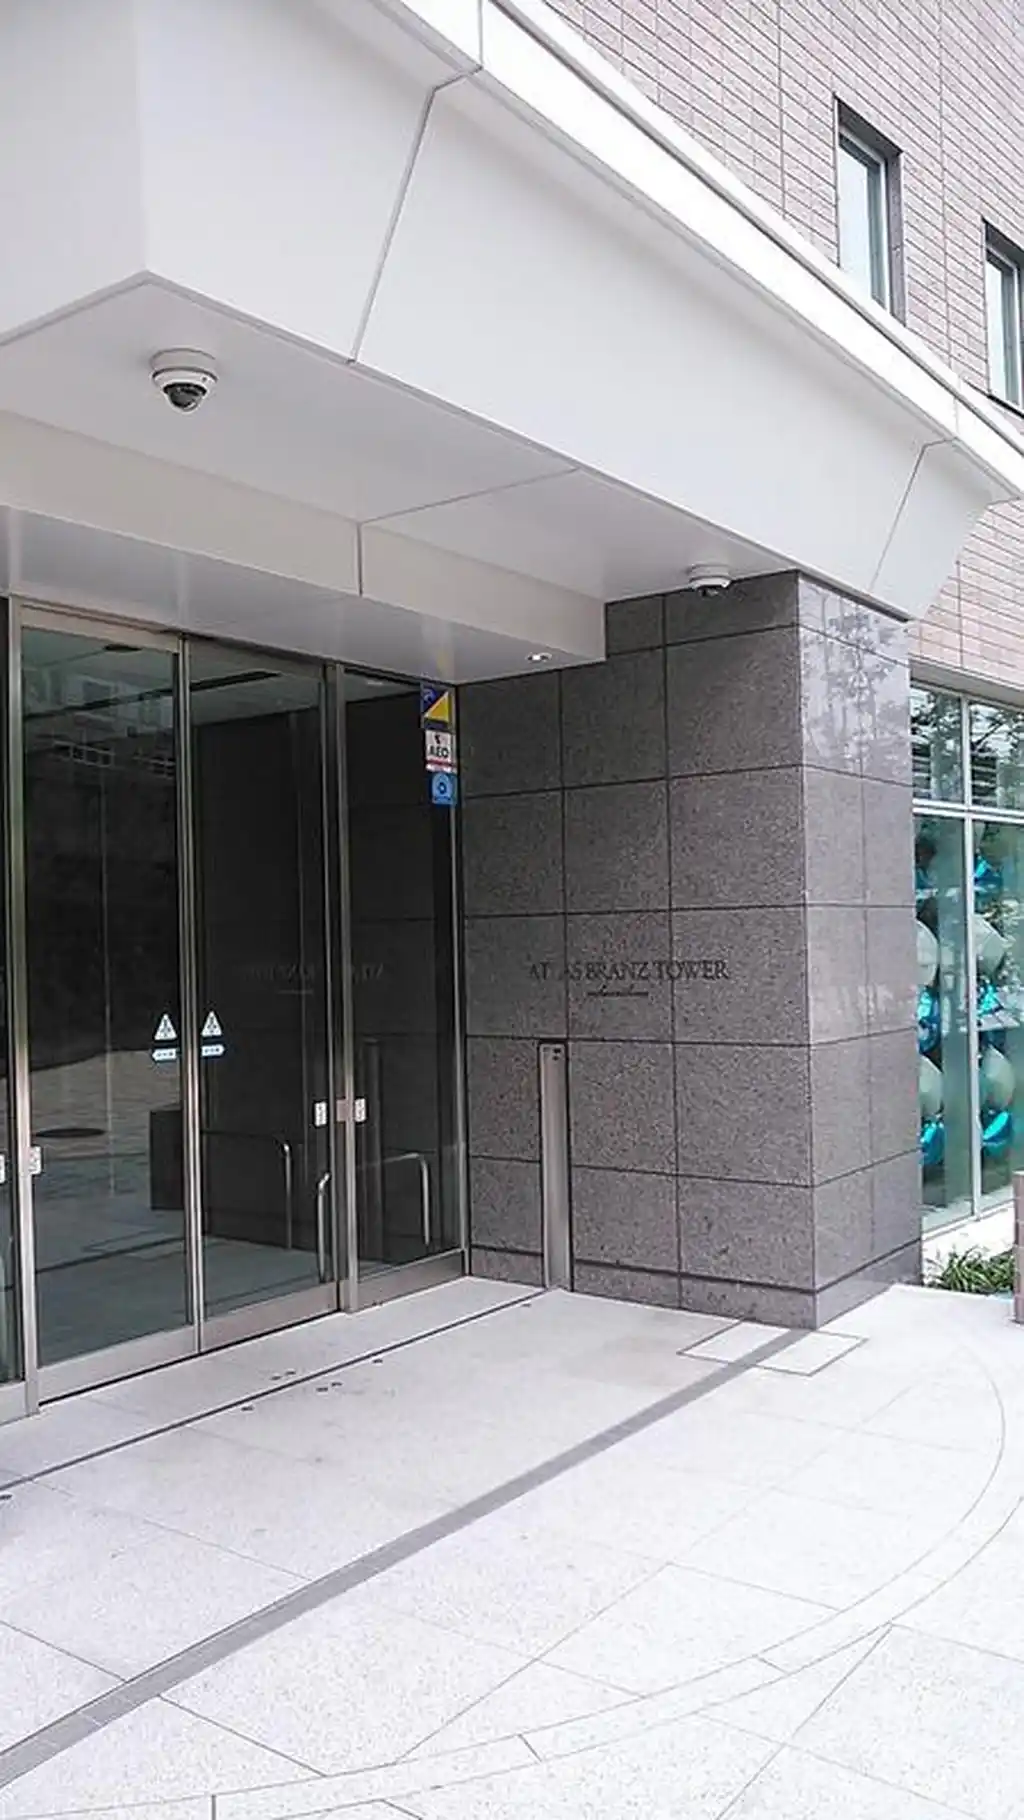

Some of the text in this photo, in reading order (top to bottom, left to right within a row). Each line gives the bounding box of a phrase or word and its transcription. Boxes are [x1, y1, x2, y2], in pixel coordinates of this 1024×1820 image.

[529, 960, 730, 981] ATAS BRANZ TOWER
